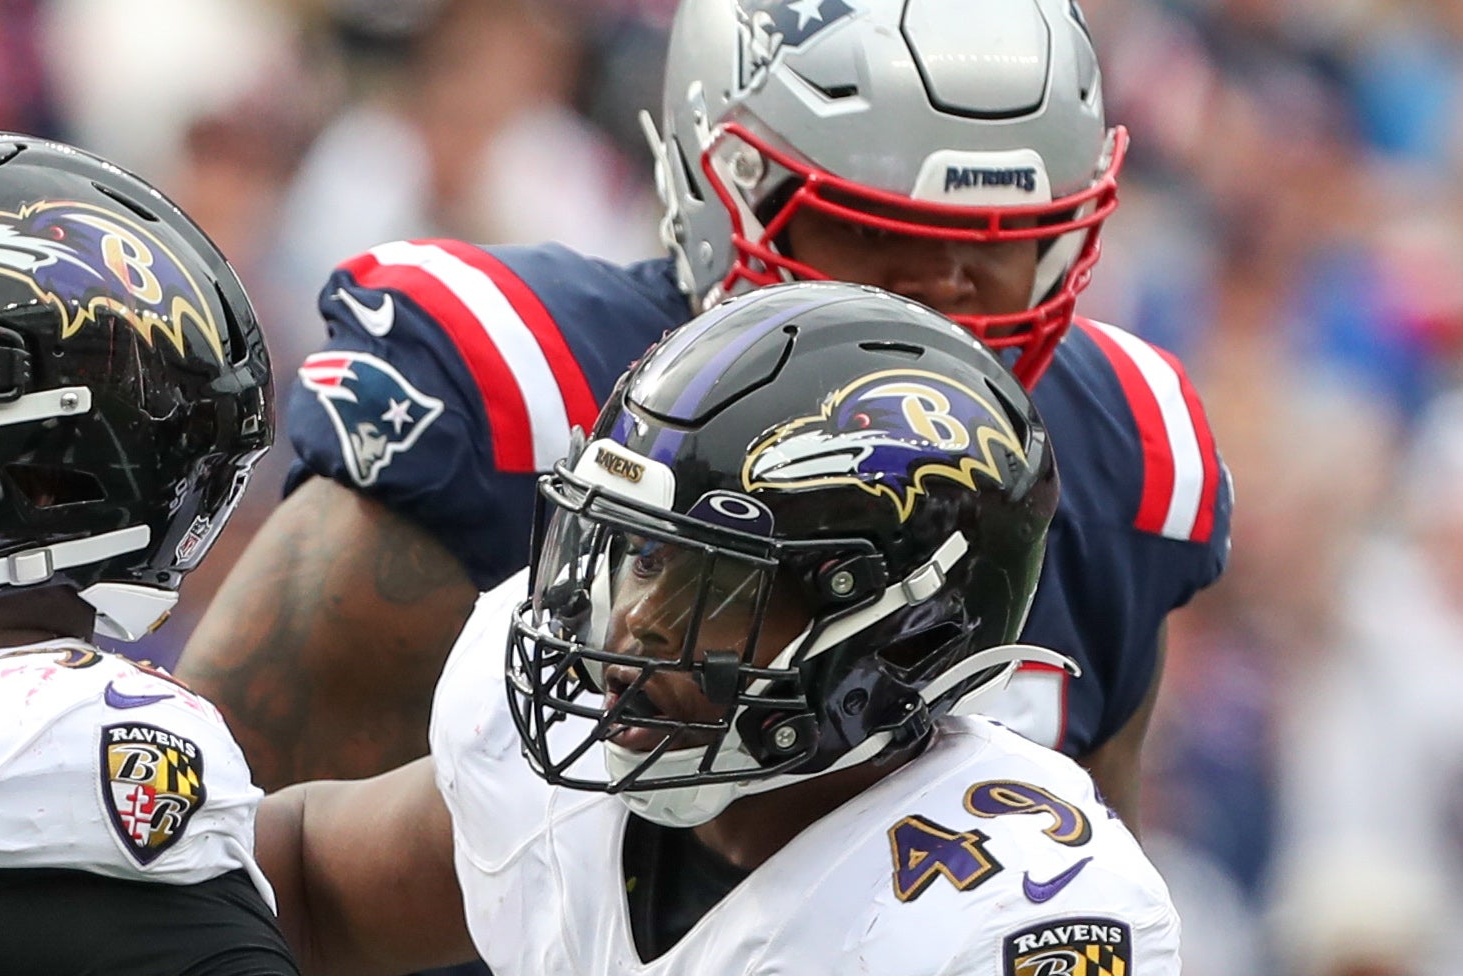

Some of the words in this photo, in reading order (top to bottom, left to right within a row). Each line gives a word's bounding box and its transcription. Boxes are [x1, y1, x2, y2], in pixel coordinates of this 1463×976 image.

[944, 166, 1036, 193] PATRIOTS
[857, 382, 970, 451] B
[595, 446, 645, 484] RAVENS
[109, 727, 197, 759] RAVENS
[110, 743, 163, 784] B
[887, 779, 1093, 904] 49
[1013, 924, 1123, 954] RAVENS
